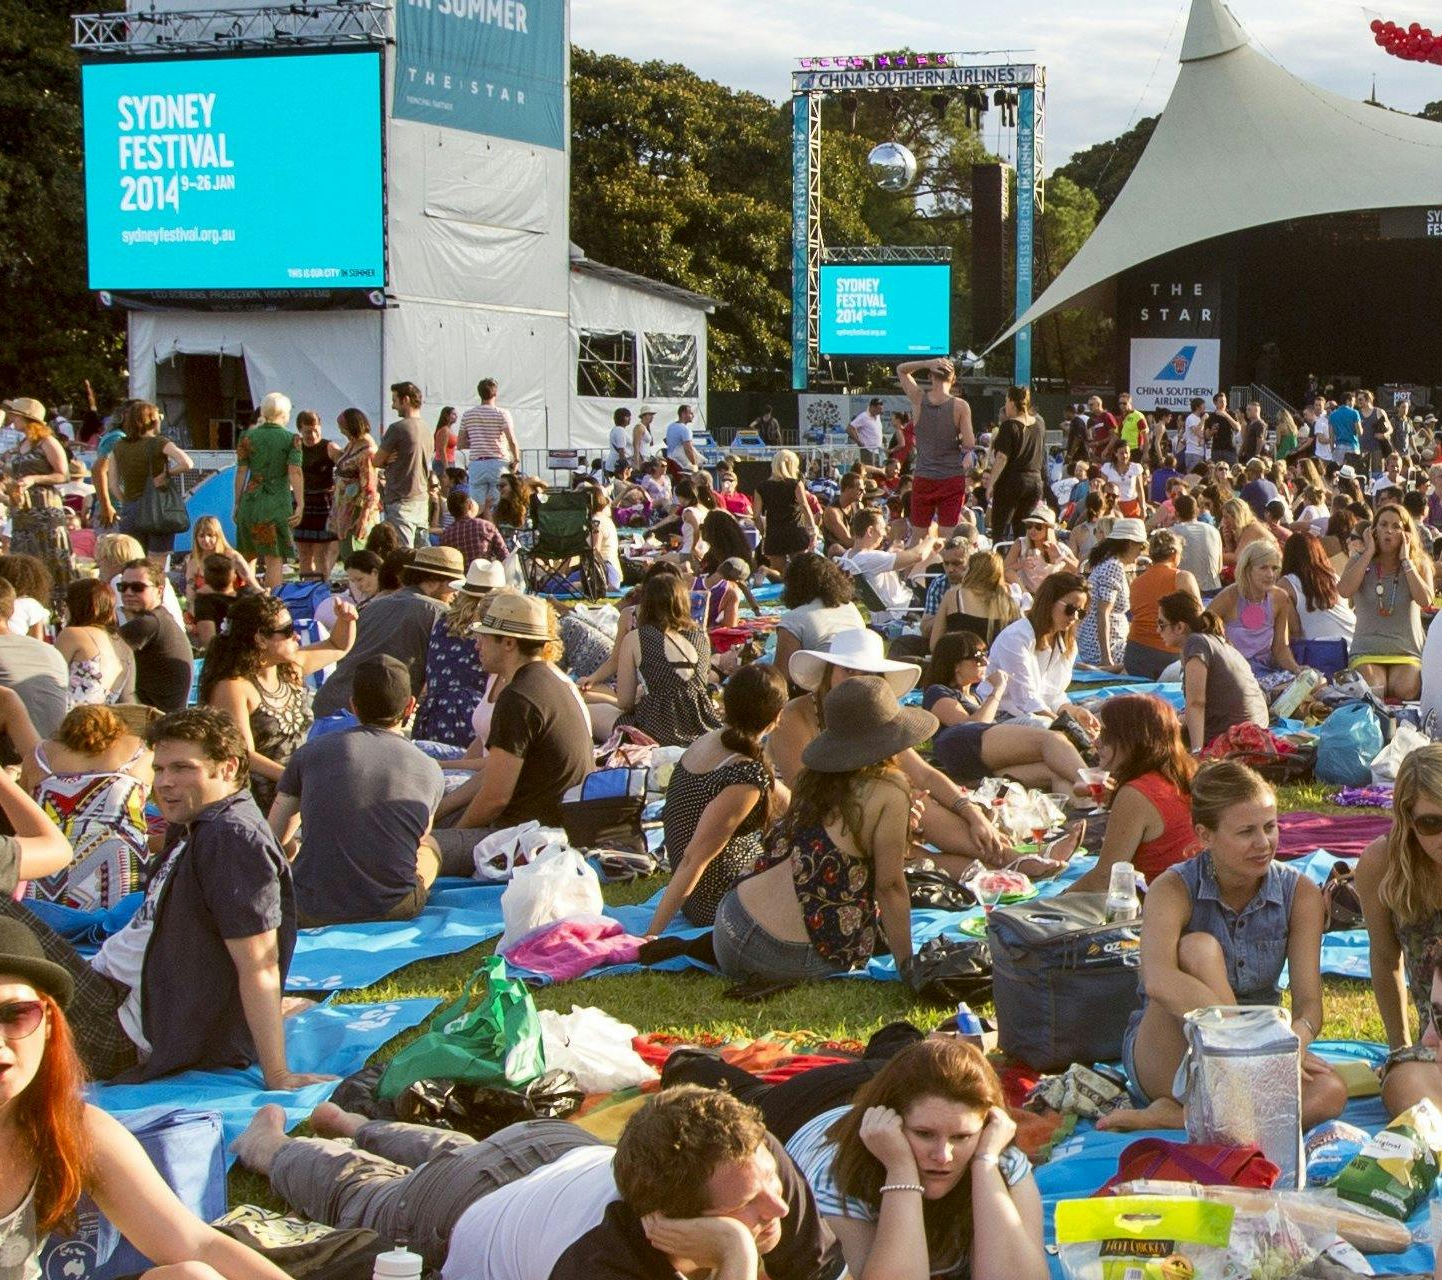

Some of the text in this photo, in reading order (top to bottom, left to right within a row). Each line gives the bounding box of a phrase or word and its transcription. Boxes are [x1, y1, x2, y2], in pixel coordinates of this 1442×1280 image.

[408, 68, 525, 105] THE STAR
[819, 67, 1015, 88] CHINA SOUTHERN AIRLINES
[118, 93, 216, 131] SYDNEY
[119, 133, 235, 170] FESTIVAL
[1020, 128, 1032, 175] SUMMER
[120, 172, 179, 214] 2014
[213, 175, 235, 190] JAN
[122, 225, 236, 245] sydneyfestival.org.au
[1019, 219, 1030, 241] OUR
[1019, 256, 1030, 282] THIS
[836, 278, 881, 293] SYDNEY
[1150, 283, 1203, 296] THE
[836, 293, 887, 308] FESTIVAL
[836, 309, 863, 324] 2014
[1140, 308, 1212, 321] STAR
[1136, 386, 1213, 395] CHINA SOUTHERN
